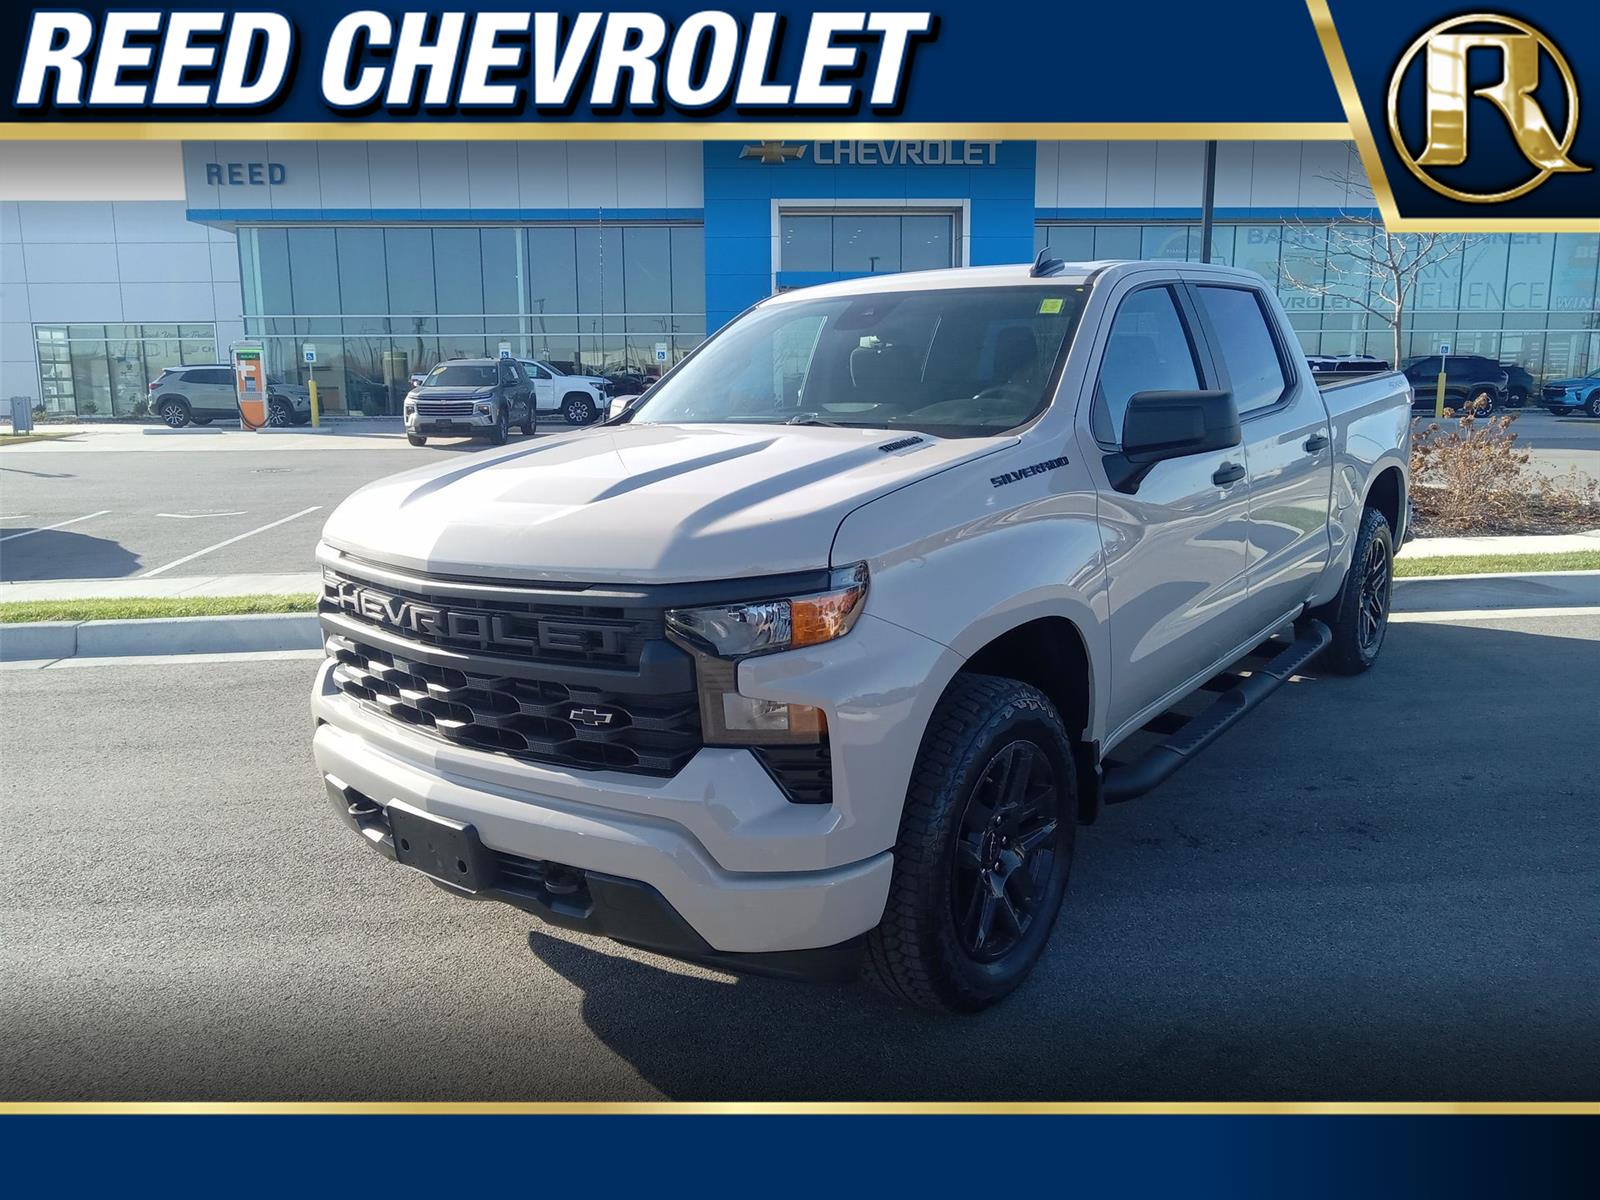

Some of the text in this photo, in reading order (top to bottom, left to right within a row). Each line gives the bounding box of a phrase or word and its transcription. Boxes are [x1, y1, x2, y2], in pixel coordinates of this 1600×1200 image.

[813, 139, 1003, 165] CHEVROLET
[206, 162, 287, 186] REED
[990, 456, 1070, 488] SILVERADO
[322, 578, 641, 651] CHEVROLET
